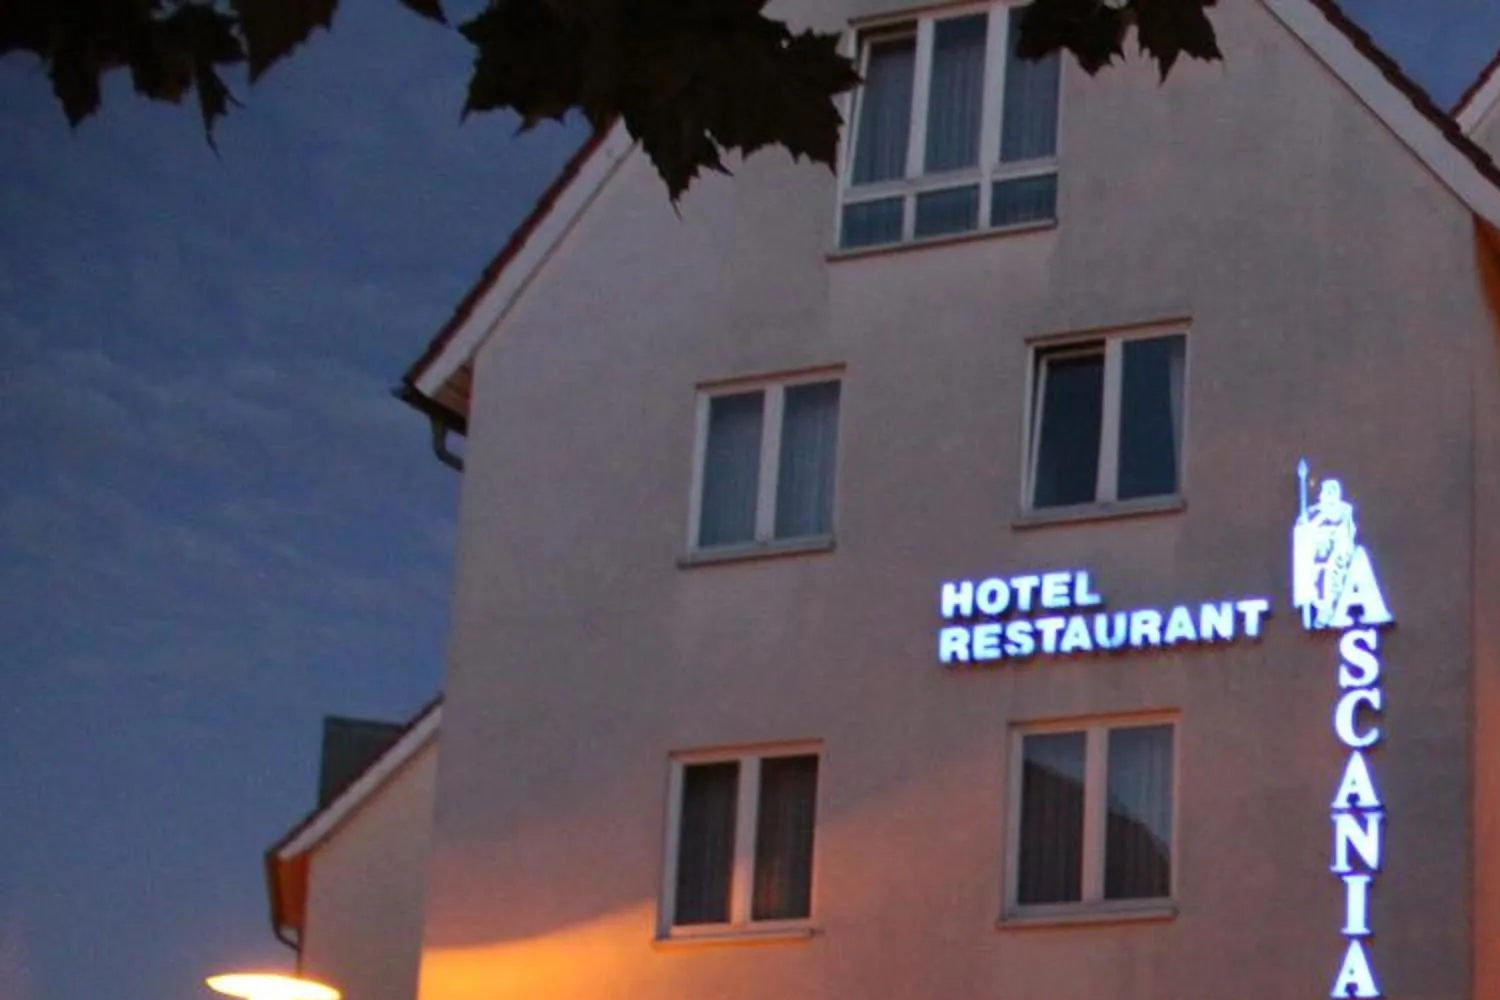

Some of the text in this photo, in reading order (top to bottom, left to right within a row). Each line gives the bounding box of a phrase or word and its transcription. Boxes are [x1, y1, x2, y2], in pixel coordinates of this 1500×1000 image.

[941, 571, 1102, 618] HOTEL
[938, 598, 1270, 662] RESTAURANT
[1329, 544, 1393, 999] ASCANIA
